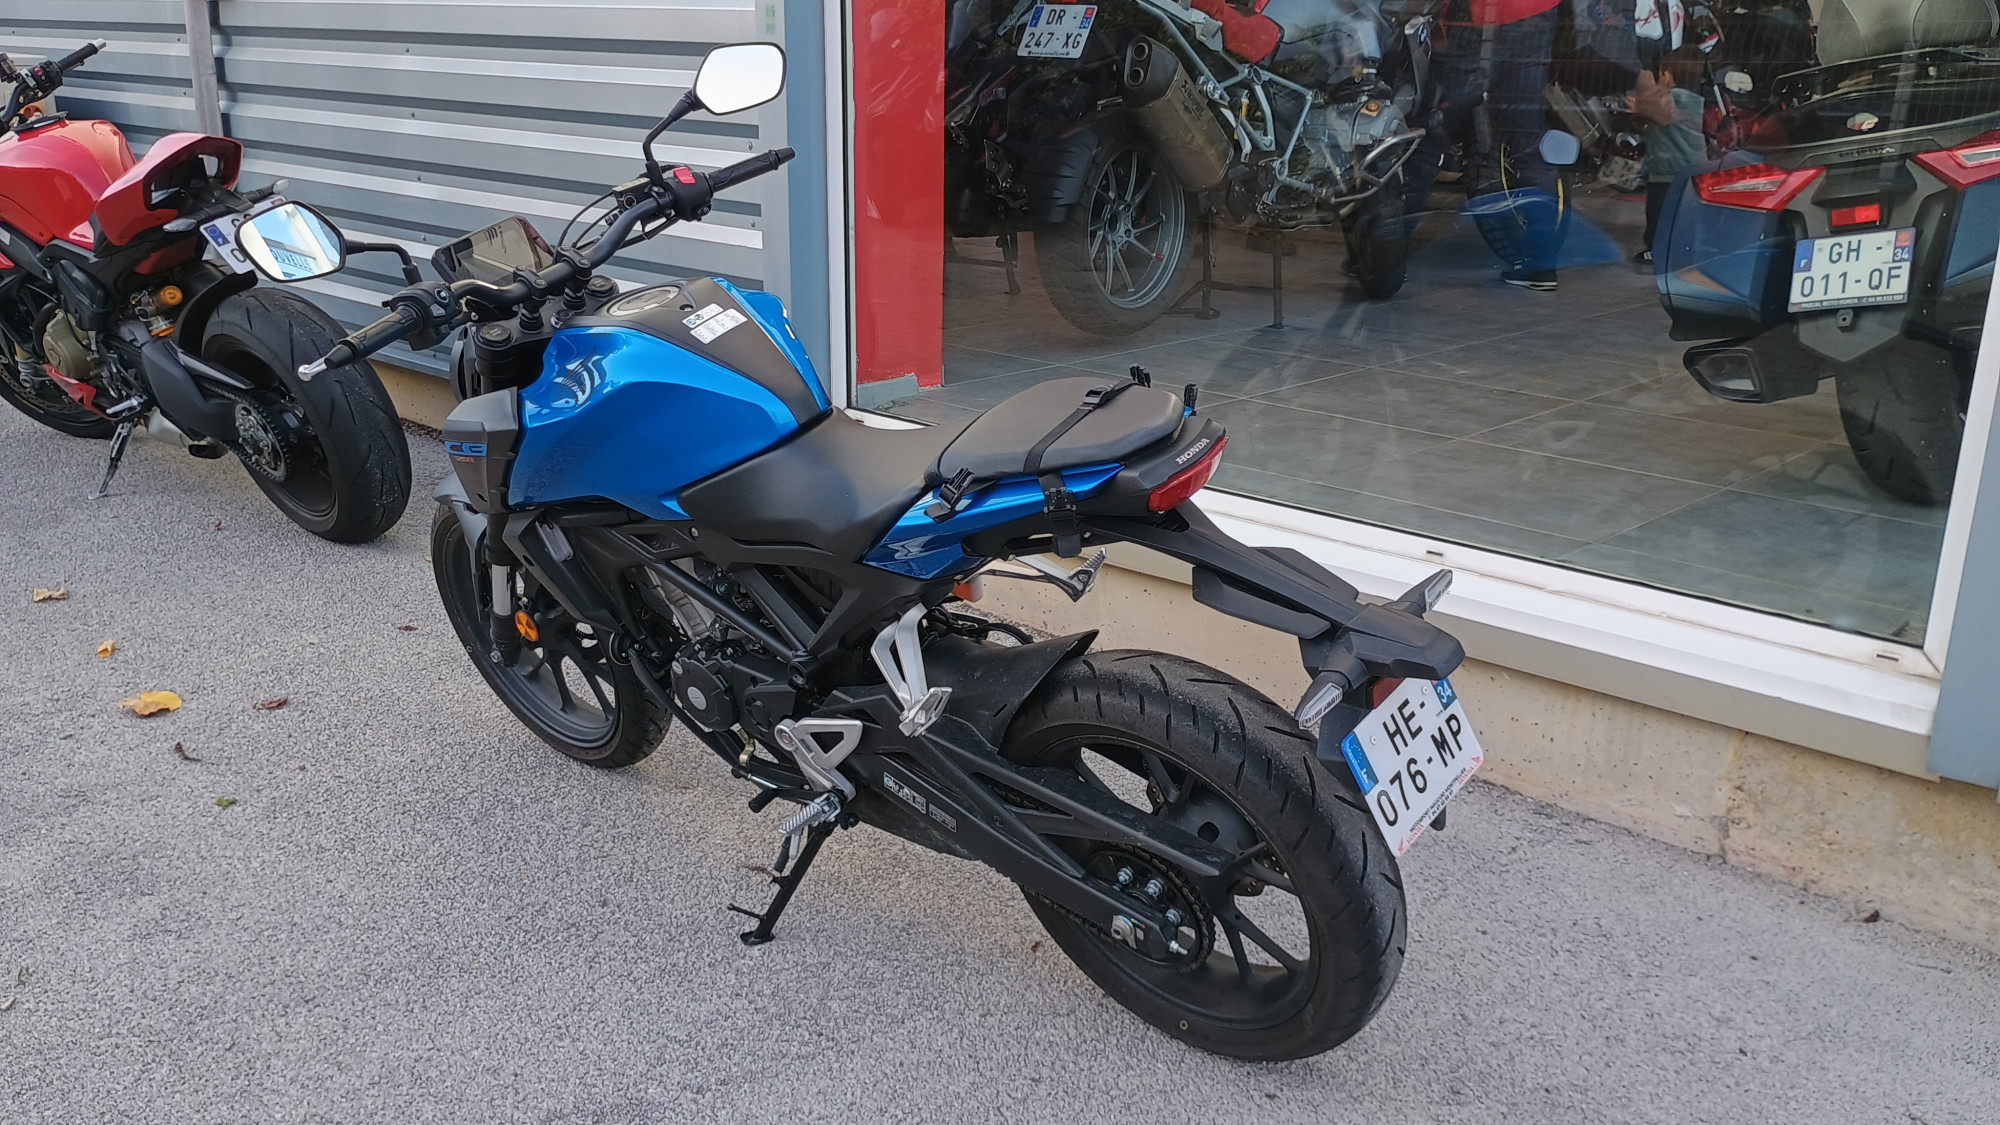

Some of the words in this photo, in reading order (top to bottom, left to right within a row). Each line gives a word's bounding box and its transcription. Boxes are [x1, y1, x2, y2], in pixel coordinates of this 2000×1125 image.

[1046, 9, 1066, 25] DR
[1080, 19, 1090, 28] 34
[1025, 32, 1082, 49] 247-XG
[1829, 240, 1861, 264] GH
[1894, 248, 1909, 260] 34
[1800, 259, 1808, 268] F
[1801, 265, 1902, 298] 011-QF
[1175, 438, 1210, 465] HONDA
[1436, 684, 1452, 703] 34
[1360, 768, 1369, 784] F
[1376, 713, 1463, 827] 076-MP
